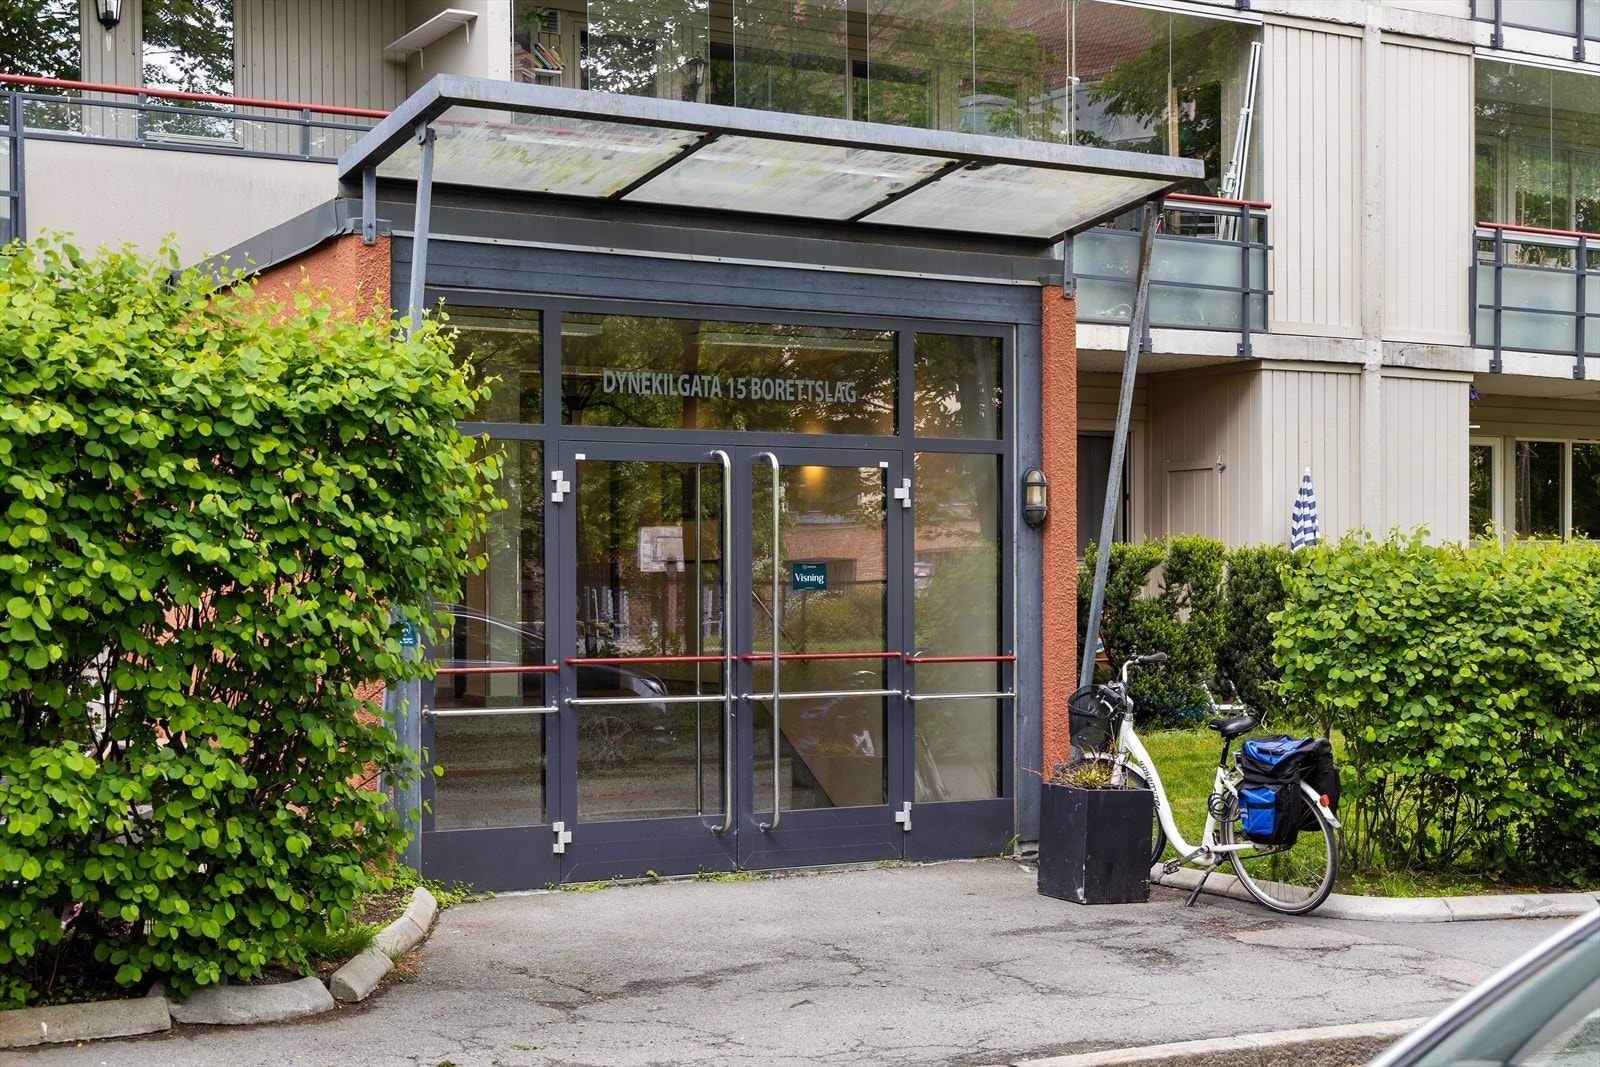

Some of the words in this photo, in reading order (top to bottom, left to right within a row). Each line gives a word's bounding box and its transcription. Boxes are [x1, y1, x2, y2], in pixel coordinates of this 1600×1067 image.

[603, 370, 722, 398] DYNEKILGATA
[727, 377, 746, 399] 15
[751, 378, 857, 403] BORETTSLAG
[795, 573, 825, 584] Visning
